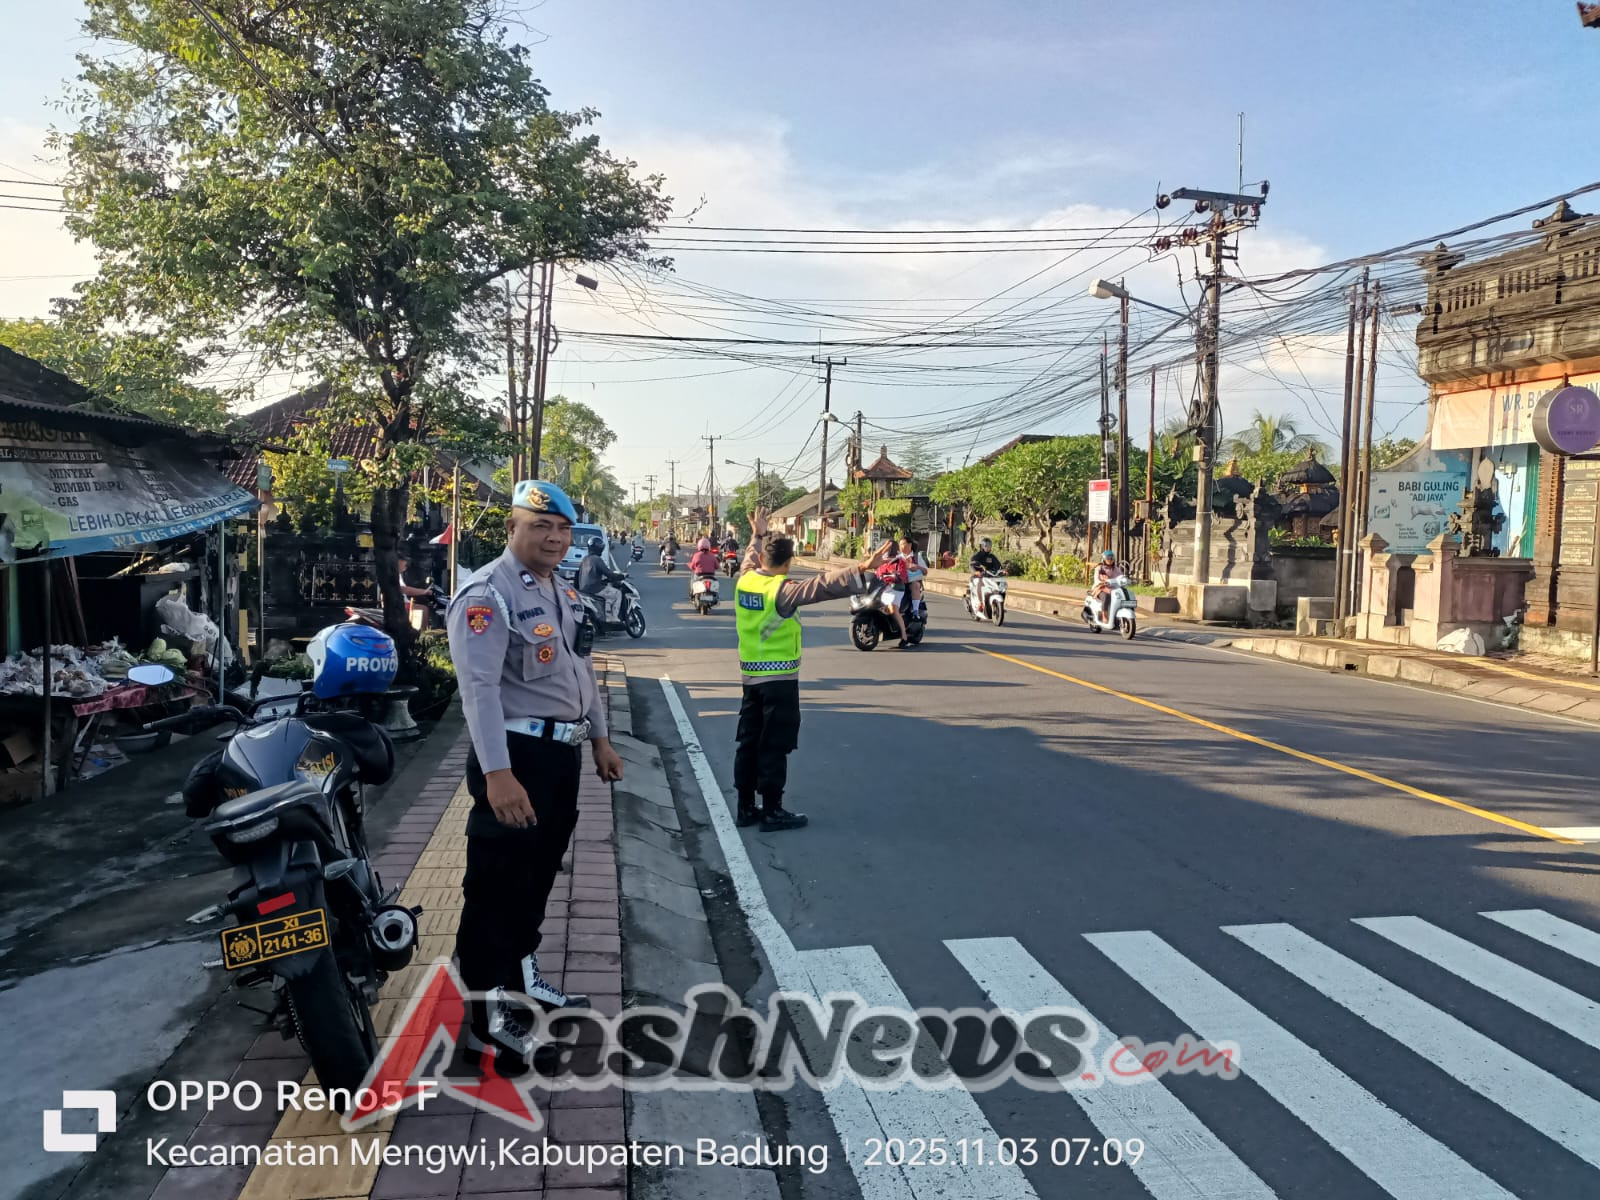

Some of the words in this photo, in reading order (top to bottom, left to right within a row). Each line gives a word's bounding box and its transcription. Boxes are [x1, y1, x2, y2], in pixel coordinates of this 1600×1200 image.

[1398, 481, 1420, 492] BABI
[1423, 481, 1459, 492] GULING
[58, 495, 79, 508] GAS
[68, 513, 113, 532] LEBIH
[282, 917, 300, 931] XI
[263, 927, 323, 955] 2141-36
